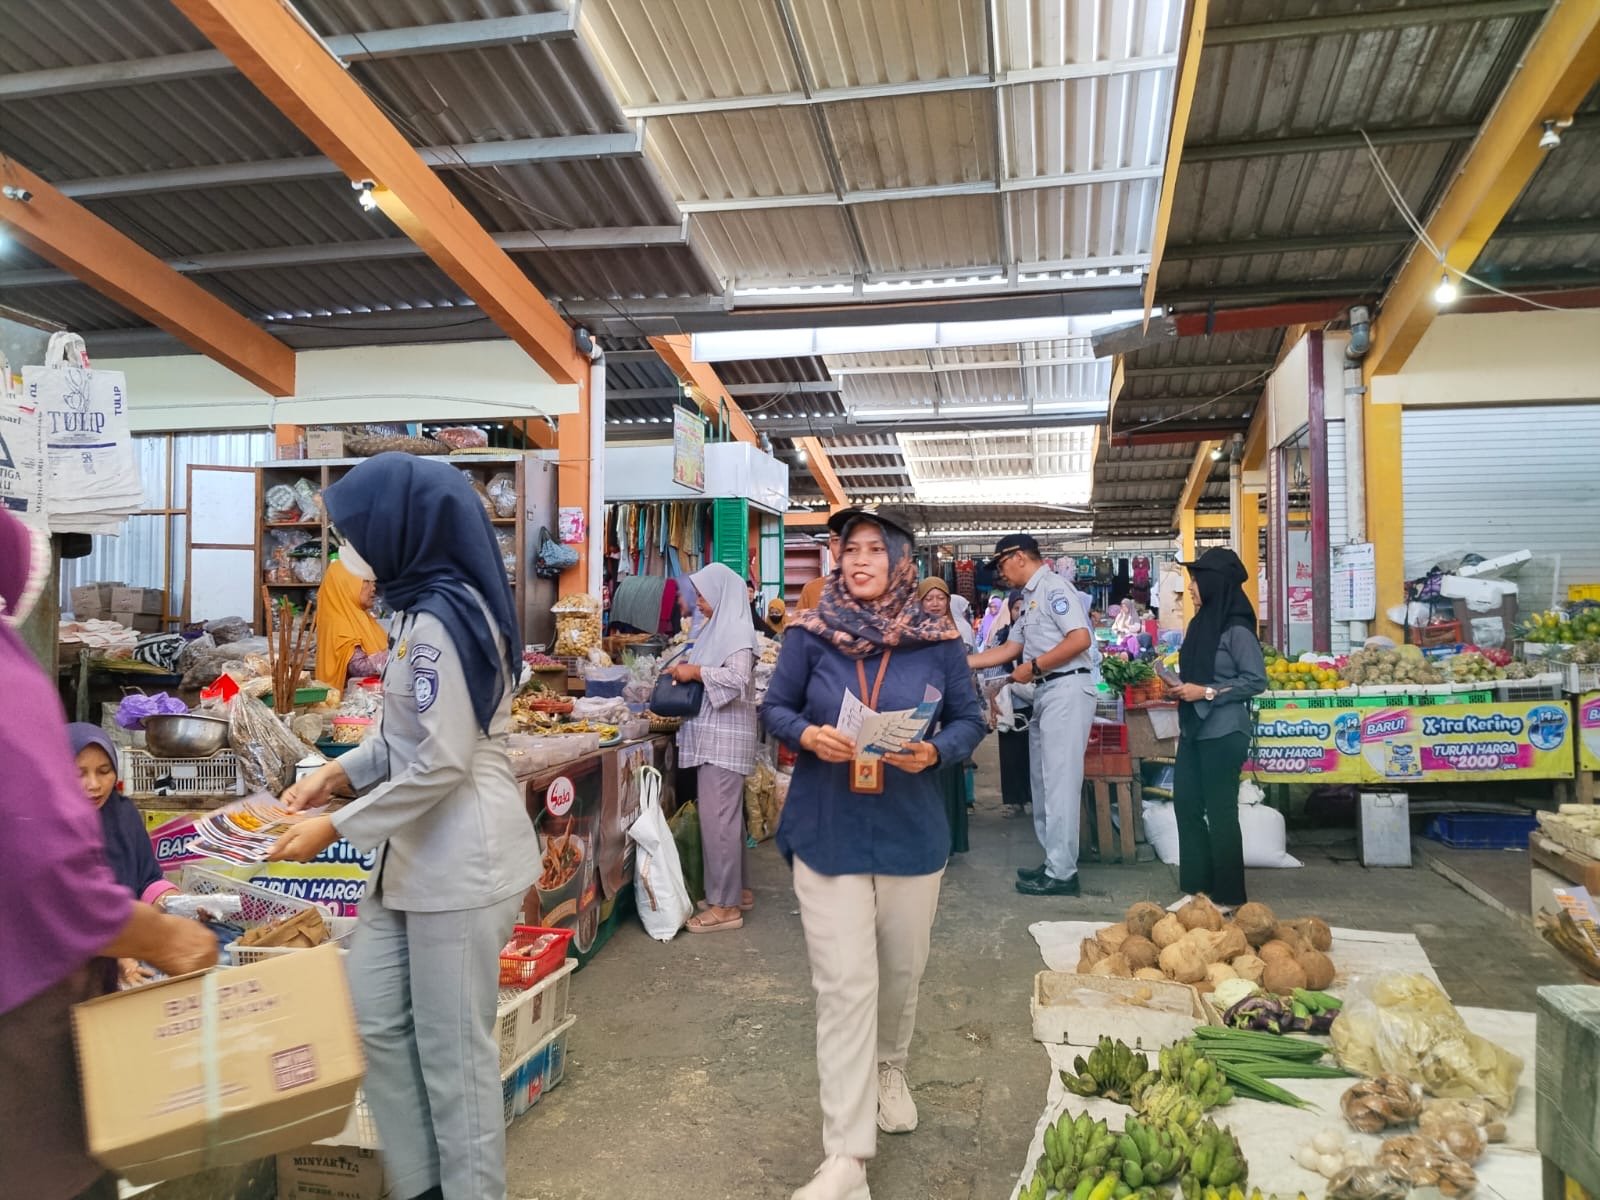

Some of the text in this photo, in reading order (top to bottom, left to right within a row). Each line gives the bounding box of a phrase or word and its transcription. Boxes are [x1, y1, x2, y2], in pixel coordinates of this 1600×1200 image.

[113, 386, 122, 416] TULIP
[1276, 721, 1329, 739] Kering
[1366, 718, 1405, 736] BARU!
[1424, 715, 1522, 734] X-tra Kering
[1284, 748, 1323, 758] HARGA
[1434, 743, 1516, 756] TURUN HARGA
[158, 835, 201, 857] BAR
